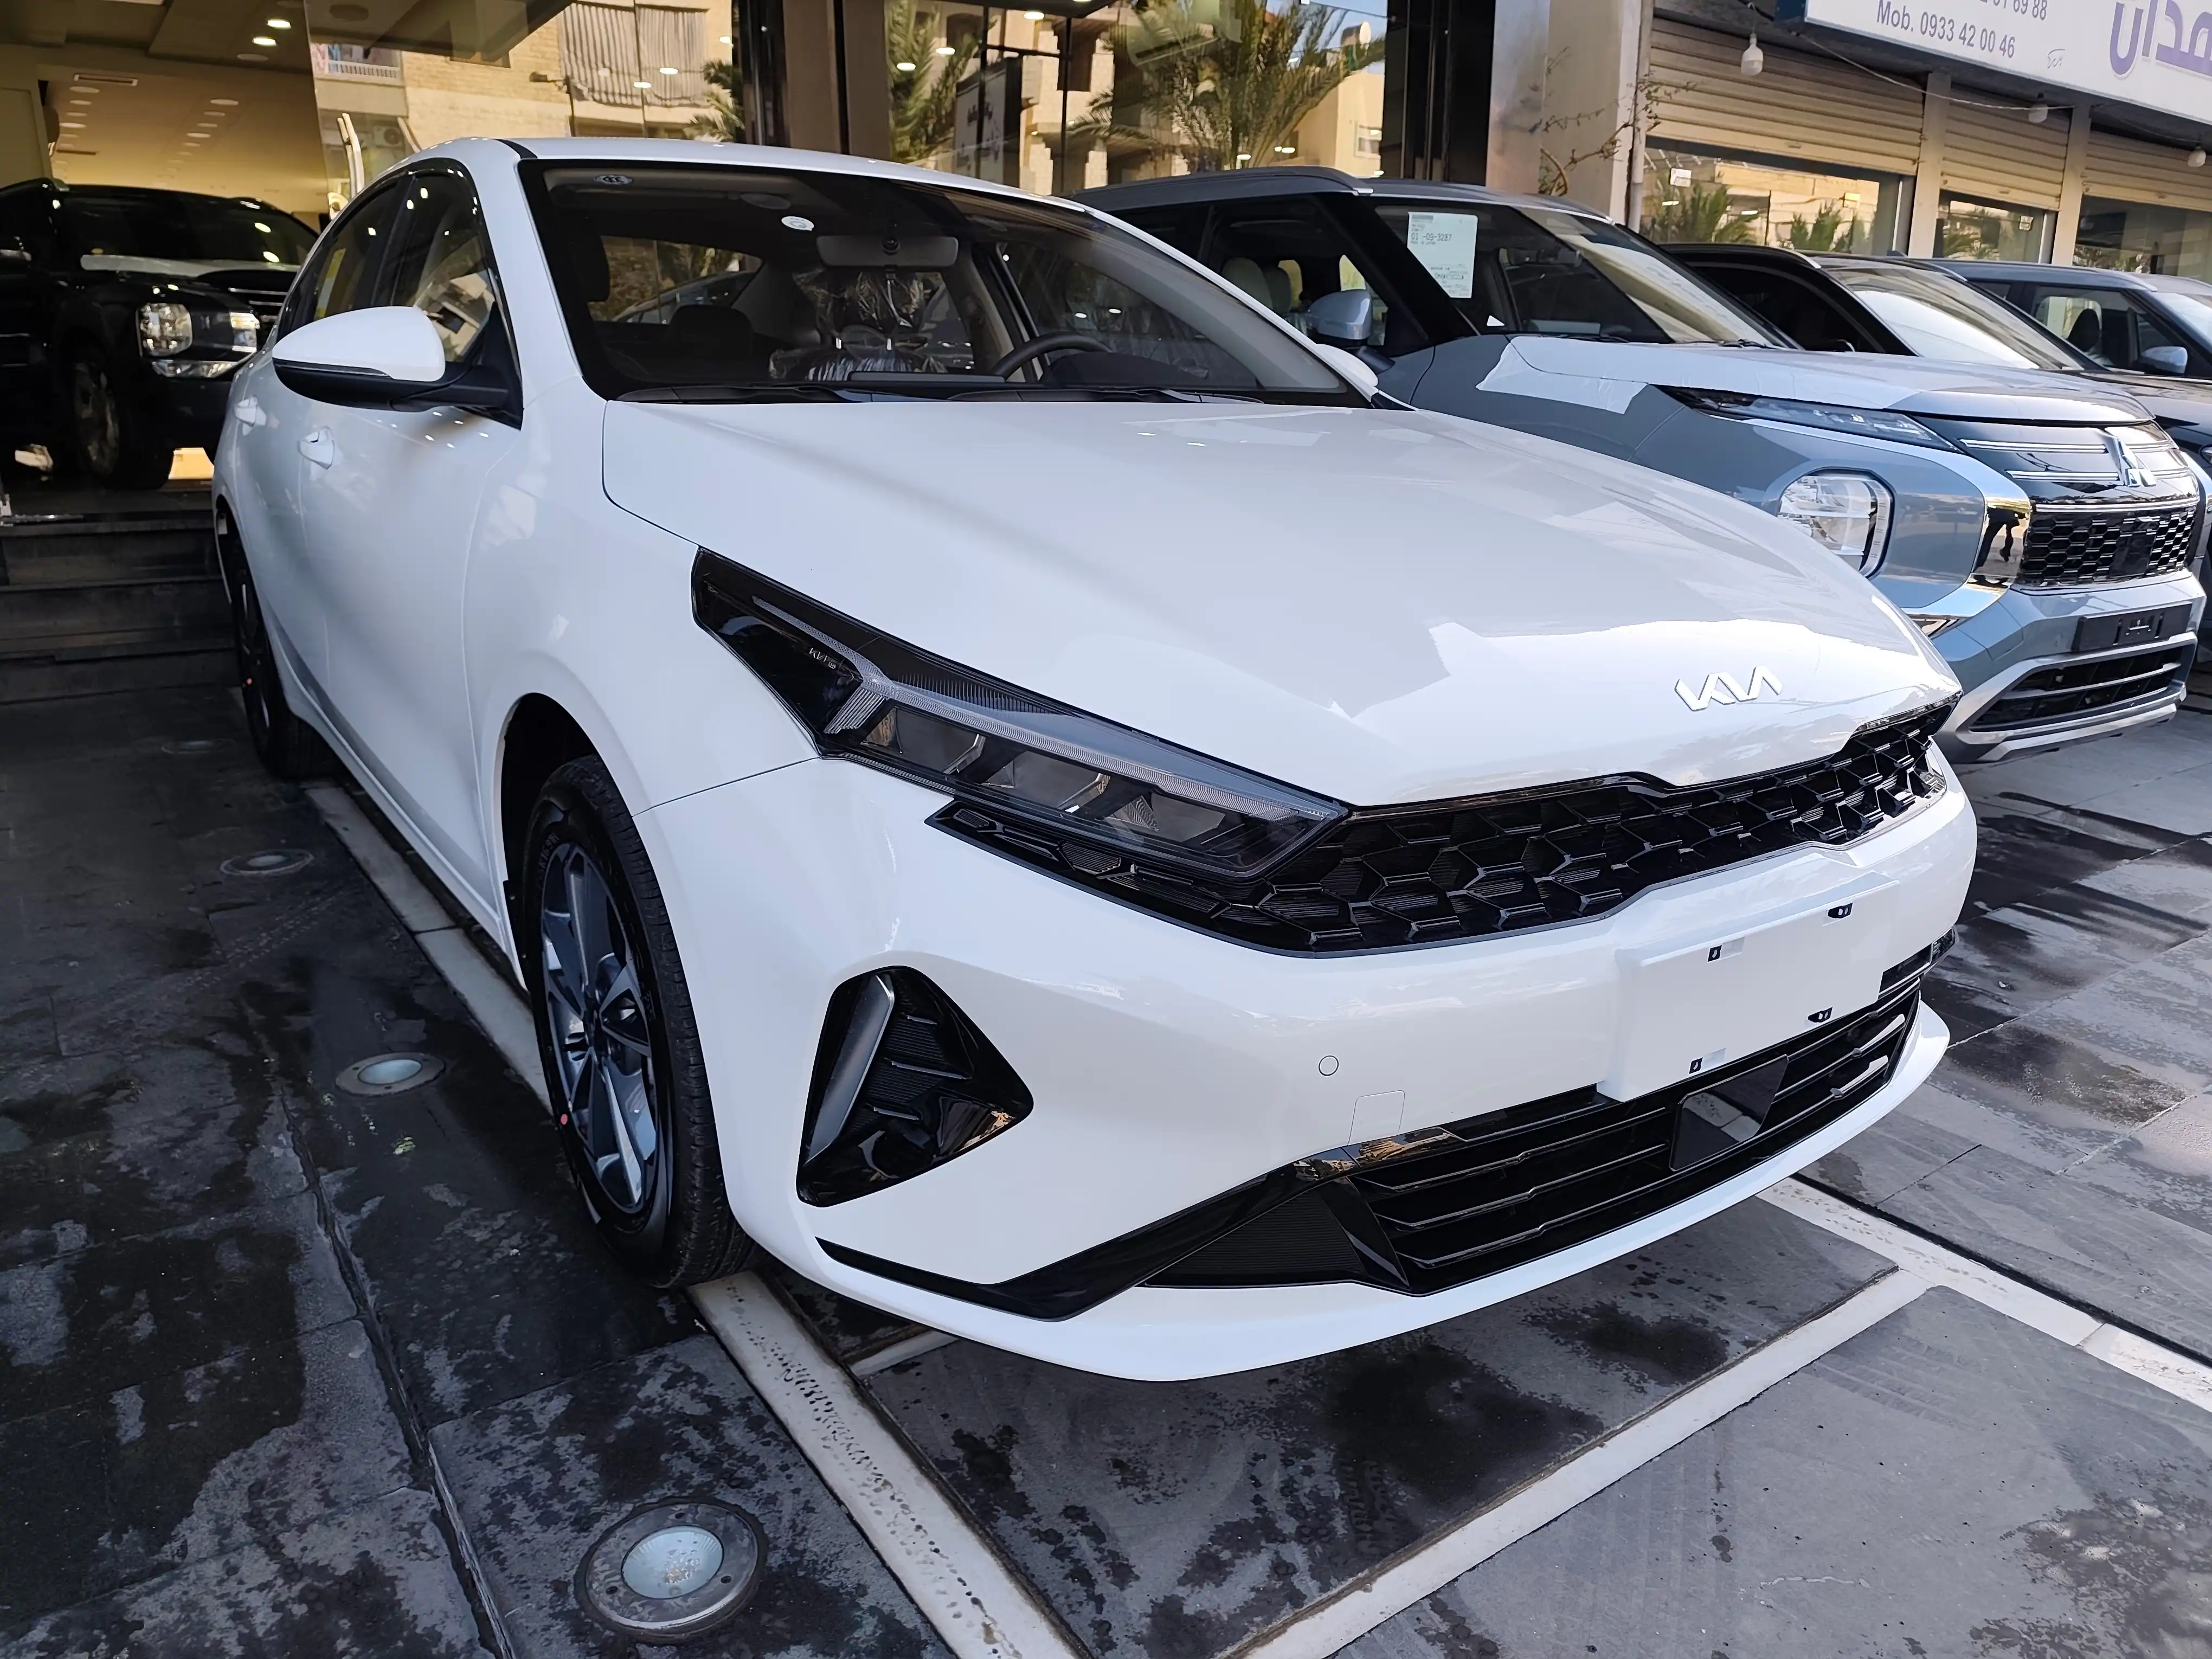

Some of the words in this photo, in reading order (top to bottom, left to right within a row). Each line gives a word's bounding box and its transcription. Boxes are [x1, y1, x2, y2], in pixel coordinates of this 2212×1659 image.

[1876, 1, 1914, 32] Mob.
[1921, 11, 1954, 42] 0933
[1959, 22, 1976, 47] 42
[1980, 28, 1996, 53] 00
[1999, 34, 2016, 59] 46
[2032, 0, 2048, 21] 88
[2109, 0, 2212, 77] مدان
[1674, 665, 1783, 712] KIA
